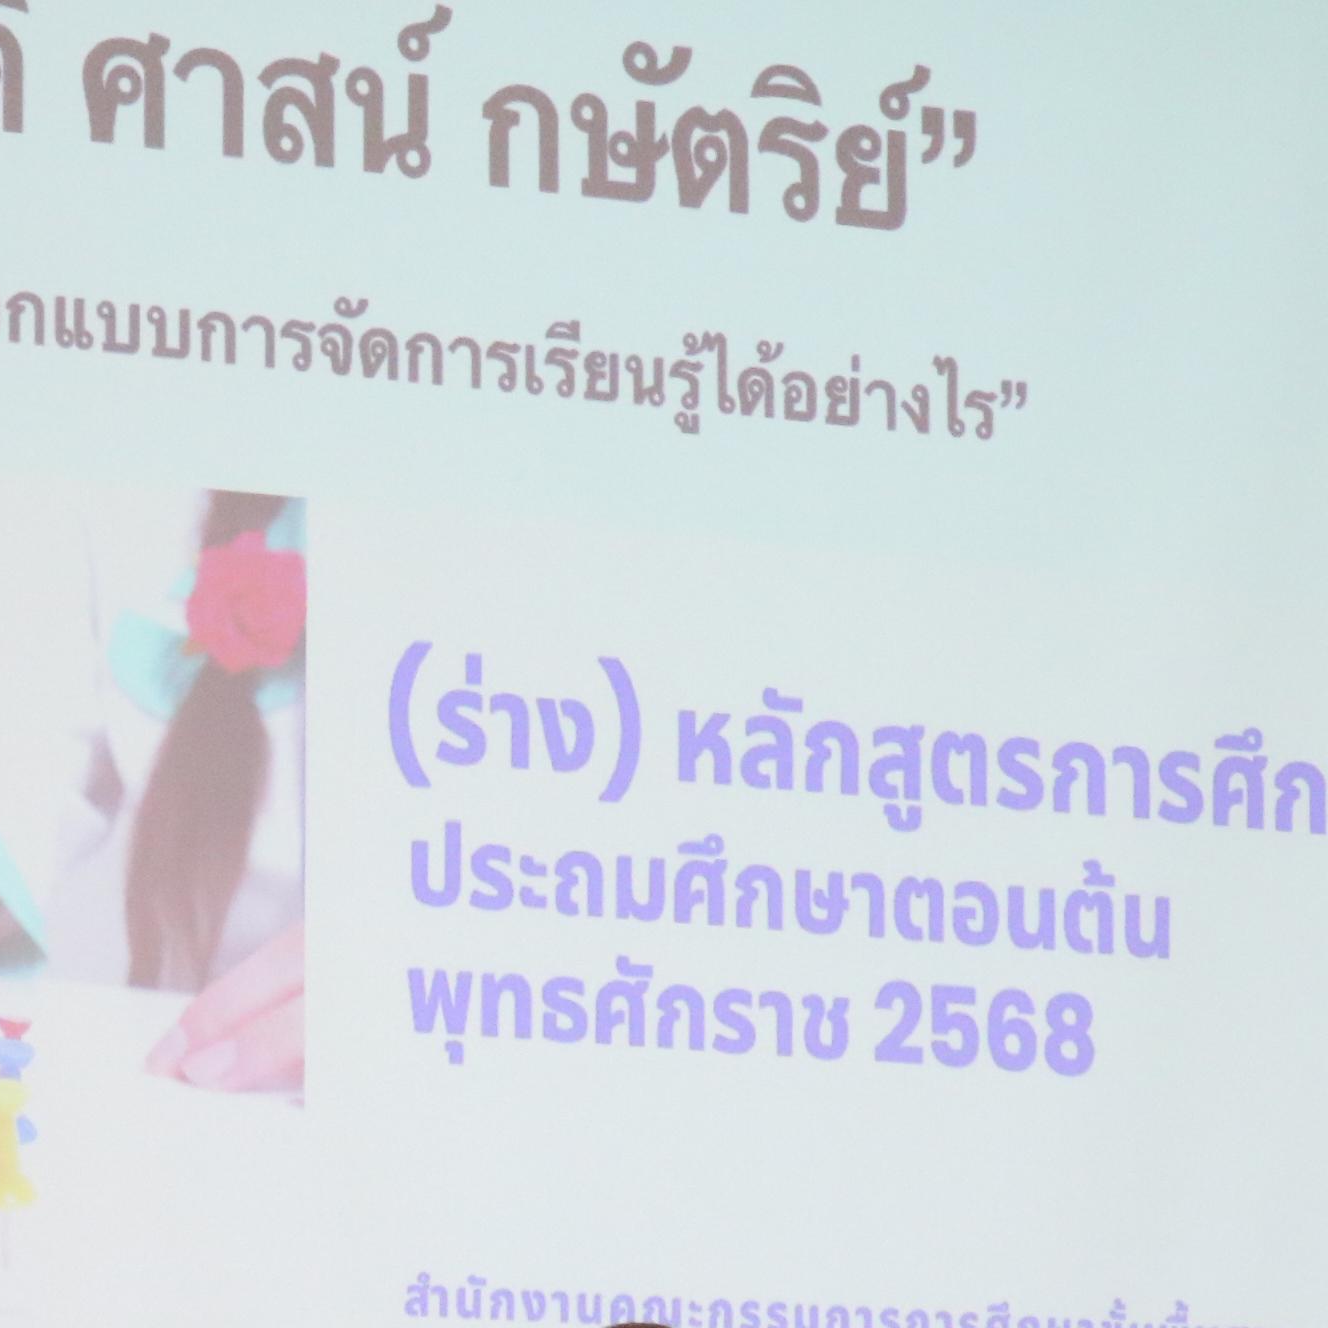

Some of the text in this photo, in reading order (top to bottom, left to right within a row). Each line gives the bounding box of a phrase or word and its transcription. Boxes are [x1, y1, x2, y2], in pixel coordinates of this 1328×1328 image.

[82, 4, 453, 179] ศาสน์
[482, 41, 978, 231] กษัตริย์”
[389, 641, 642, 803] (ร่าง)
[410, 820, 1171, 960] ประถมศึกษาตอนต้น
[407, 955, 1096, 1077] พุทธศักราช 2568
